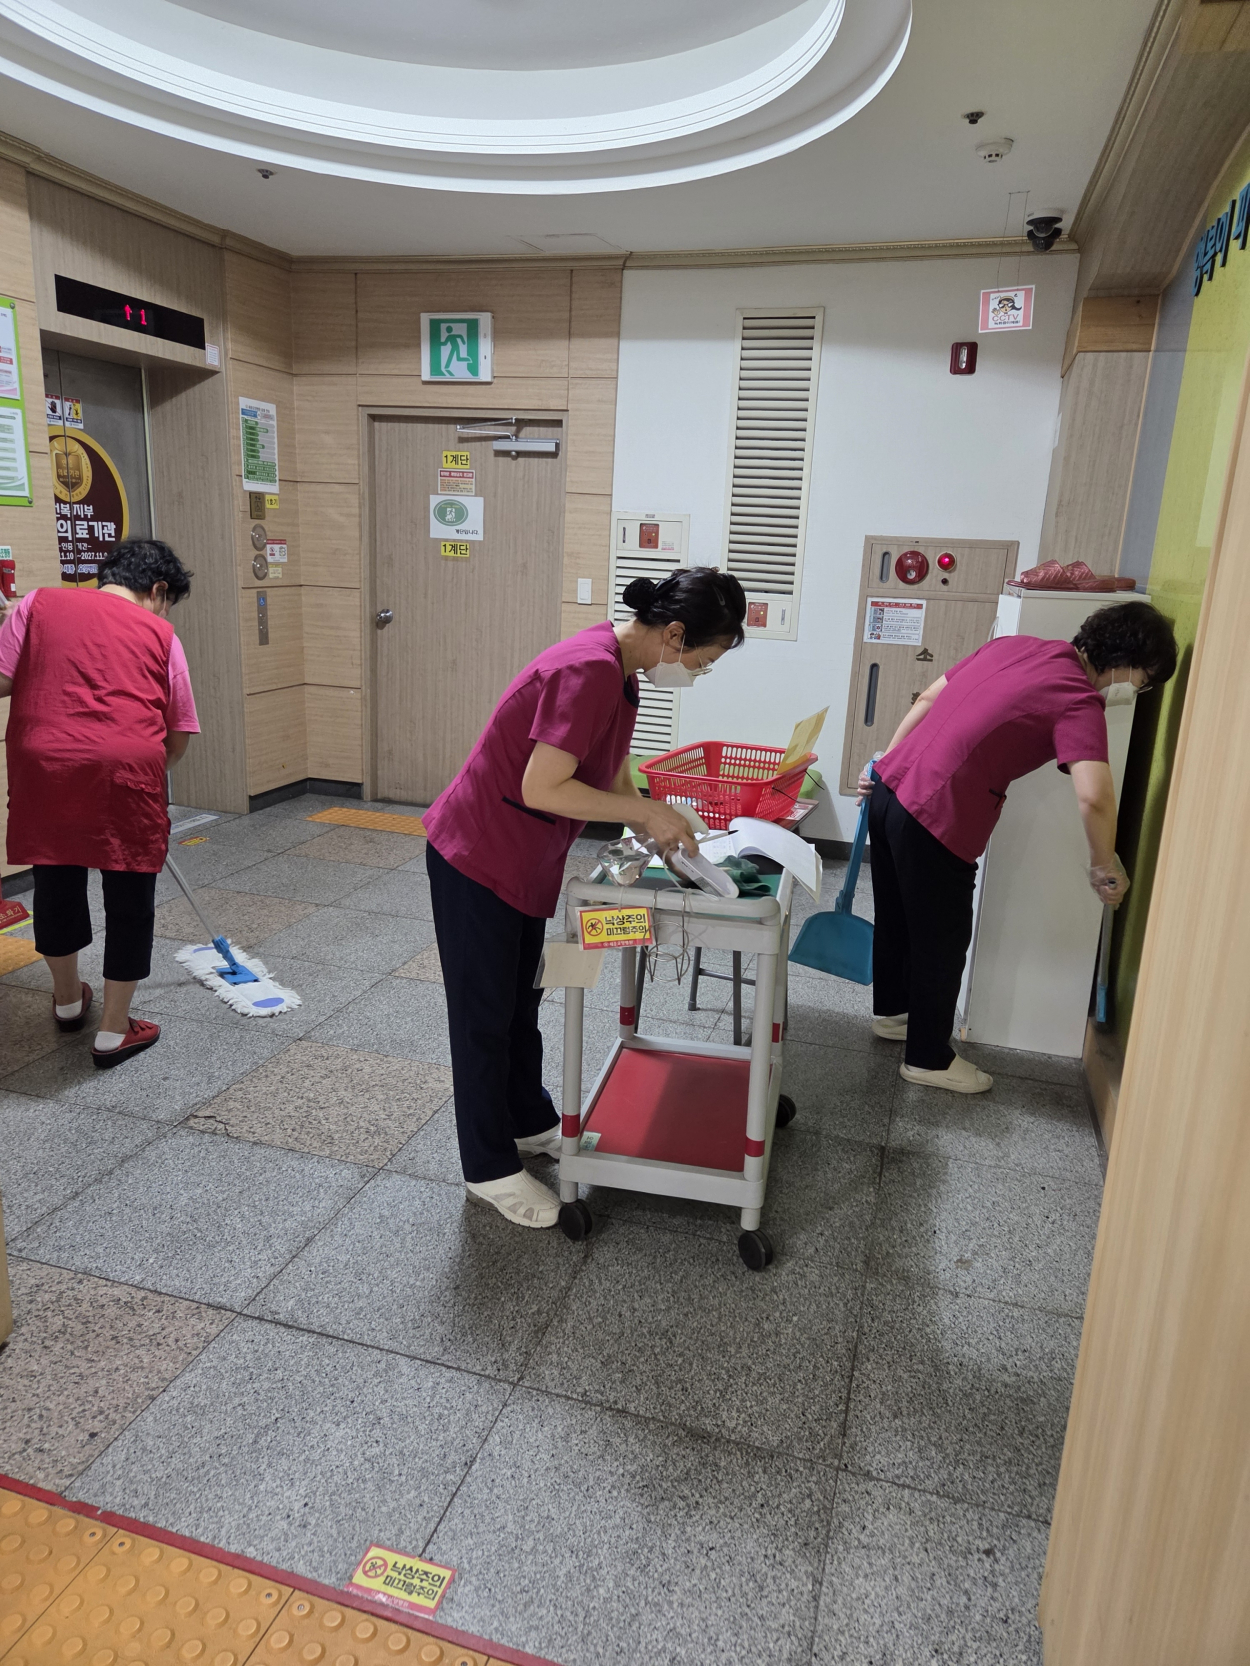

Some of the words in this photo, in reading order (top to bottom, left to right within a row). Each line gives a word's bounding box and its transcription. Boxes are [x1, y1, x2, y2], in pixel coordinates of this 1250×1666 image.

[140, 308, 148, 326] 1
[992, 314, 1019, 322] CCTV
[443, 454, 470, 466] 1계단
[266, 498, 278, 506] 1호기
[57, 520, 116, 541] 의료기관
[441, 543, 469, 556] 1계단
[604, 913, 646, 926] 낙상주의
[605, 925, 647, 936] 미끄럼주의
[390, 1561, 446, 1589] 낙상주의
[382, 1575, 439, 1601] 미끄럼주의
